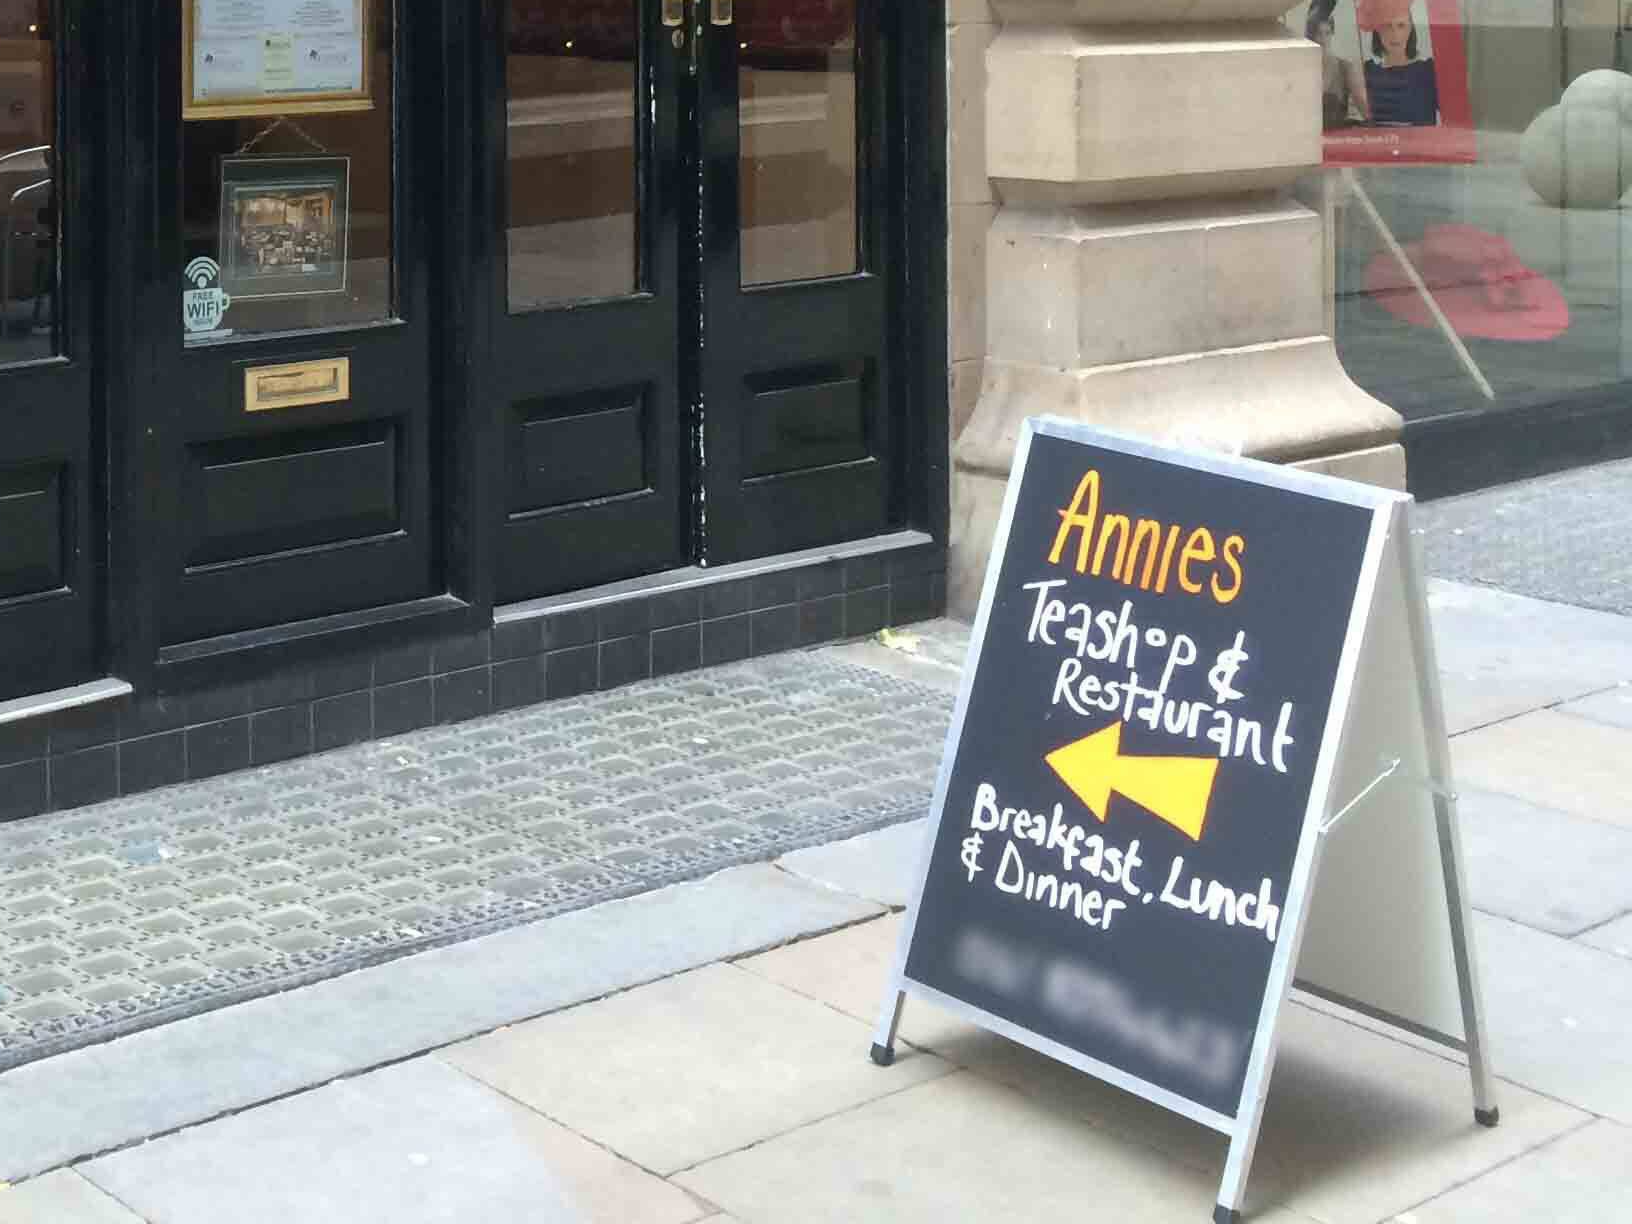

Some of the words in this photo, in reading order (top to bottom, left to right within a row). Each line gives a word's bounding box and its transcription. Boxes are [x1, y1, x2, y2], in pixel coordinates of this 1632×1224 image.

[187, 301, 219, 318] WIFI
[1047, 469, 1245, 604] Annies
[1022, 579, 1197, 694] Teashop
[1208, 630, 1249, 704] &
[1052, 657, 1295, 773] Restaurant
[961, 831, 984, 883] &
[995, 839, 1127, 930] Dinner
[1160, 856, 1280, 942] Lunch
